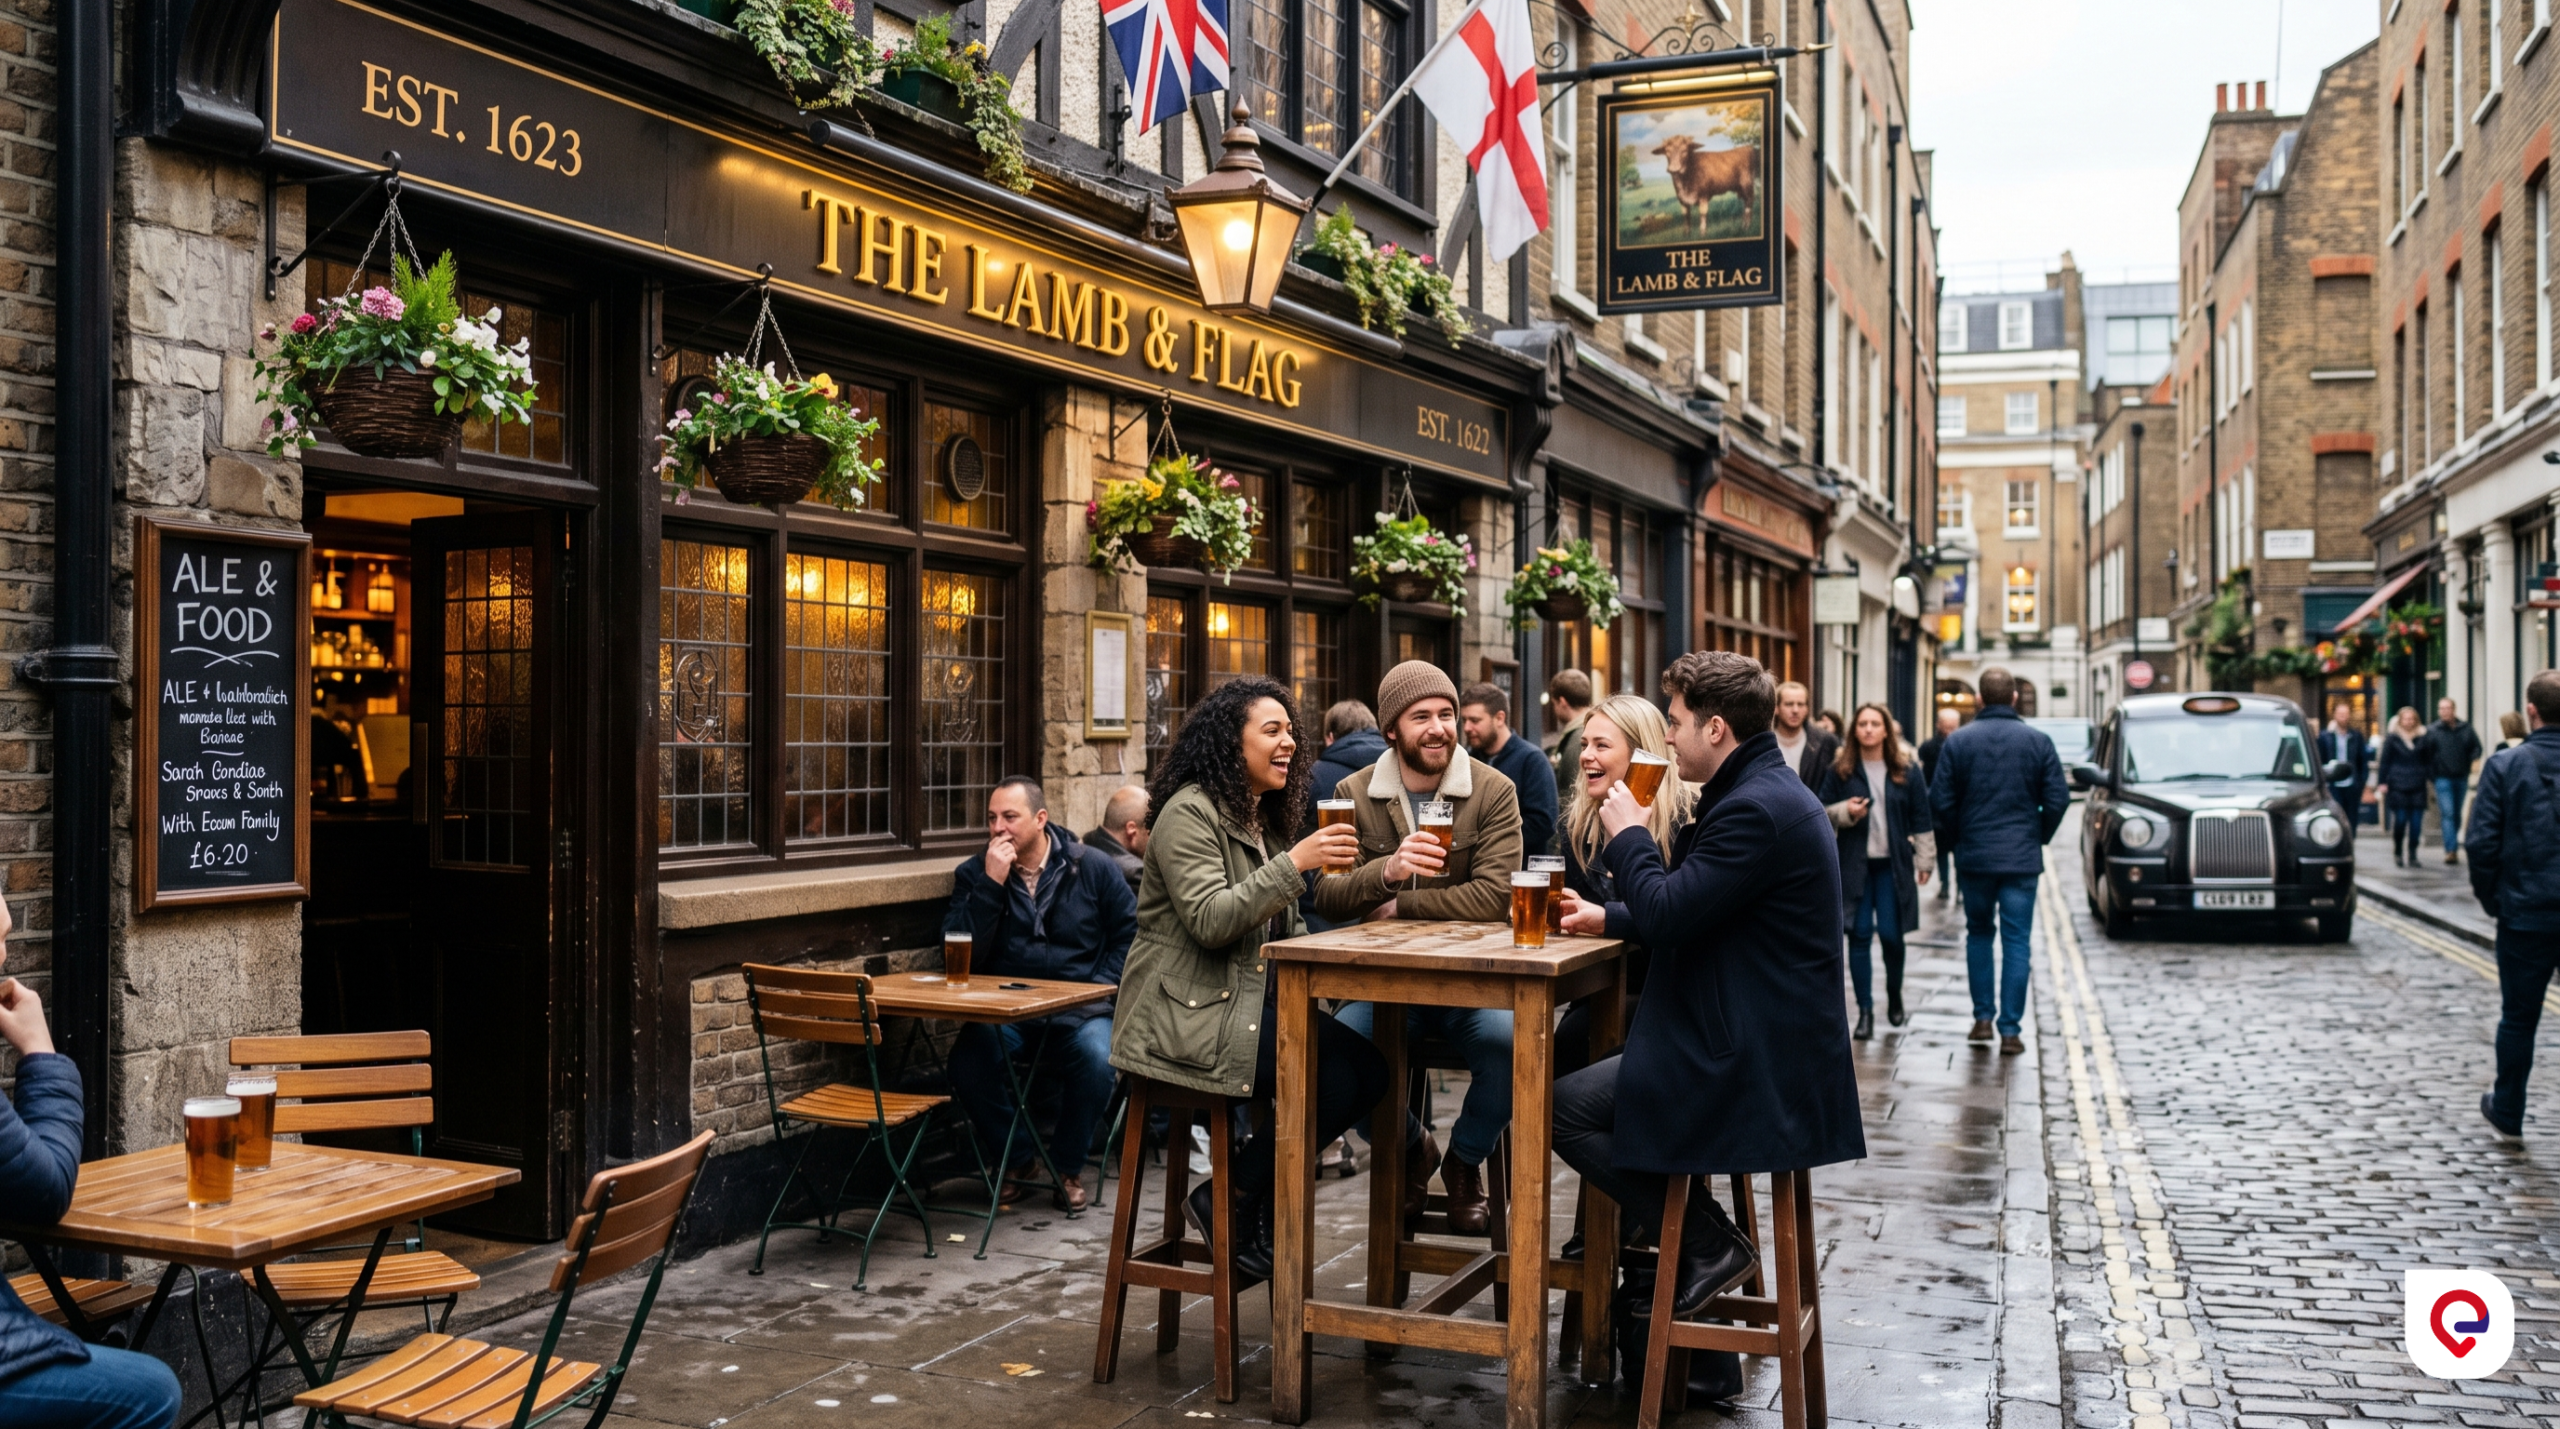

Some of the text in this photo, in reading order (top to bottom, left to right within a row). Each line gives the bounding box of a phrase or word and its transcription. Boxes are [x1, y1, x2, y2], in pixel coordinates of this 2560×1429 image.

[361, 60, 583, 177] EST. 1623
[1666, 249, 1712, 269] THE
[1617, 267, 1763, 294] LAMB & FLAG
[804, 188, 1302, 408] THE LAMB & FLAG
[1417, 405, 1490, 456] EST. 1622
[172, 553, 279, 597] ALE &
[176, 602, 273, 643] FOOD
[163, 679, 198, 704] ALE
[251, 709, 277, 726] with
[161, 760, 204, 782] Sarah
[232, 781, 242, 800] &
[162, 811, 196, 836] With
